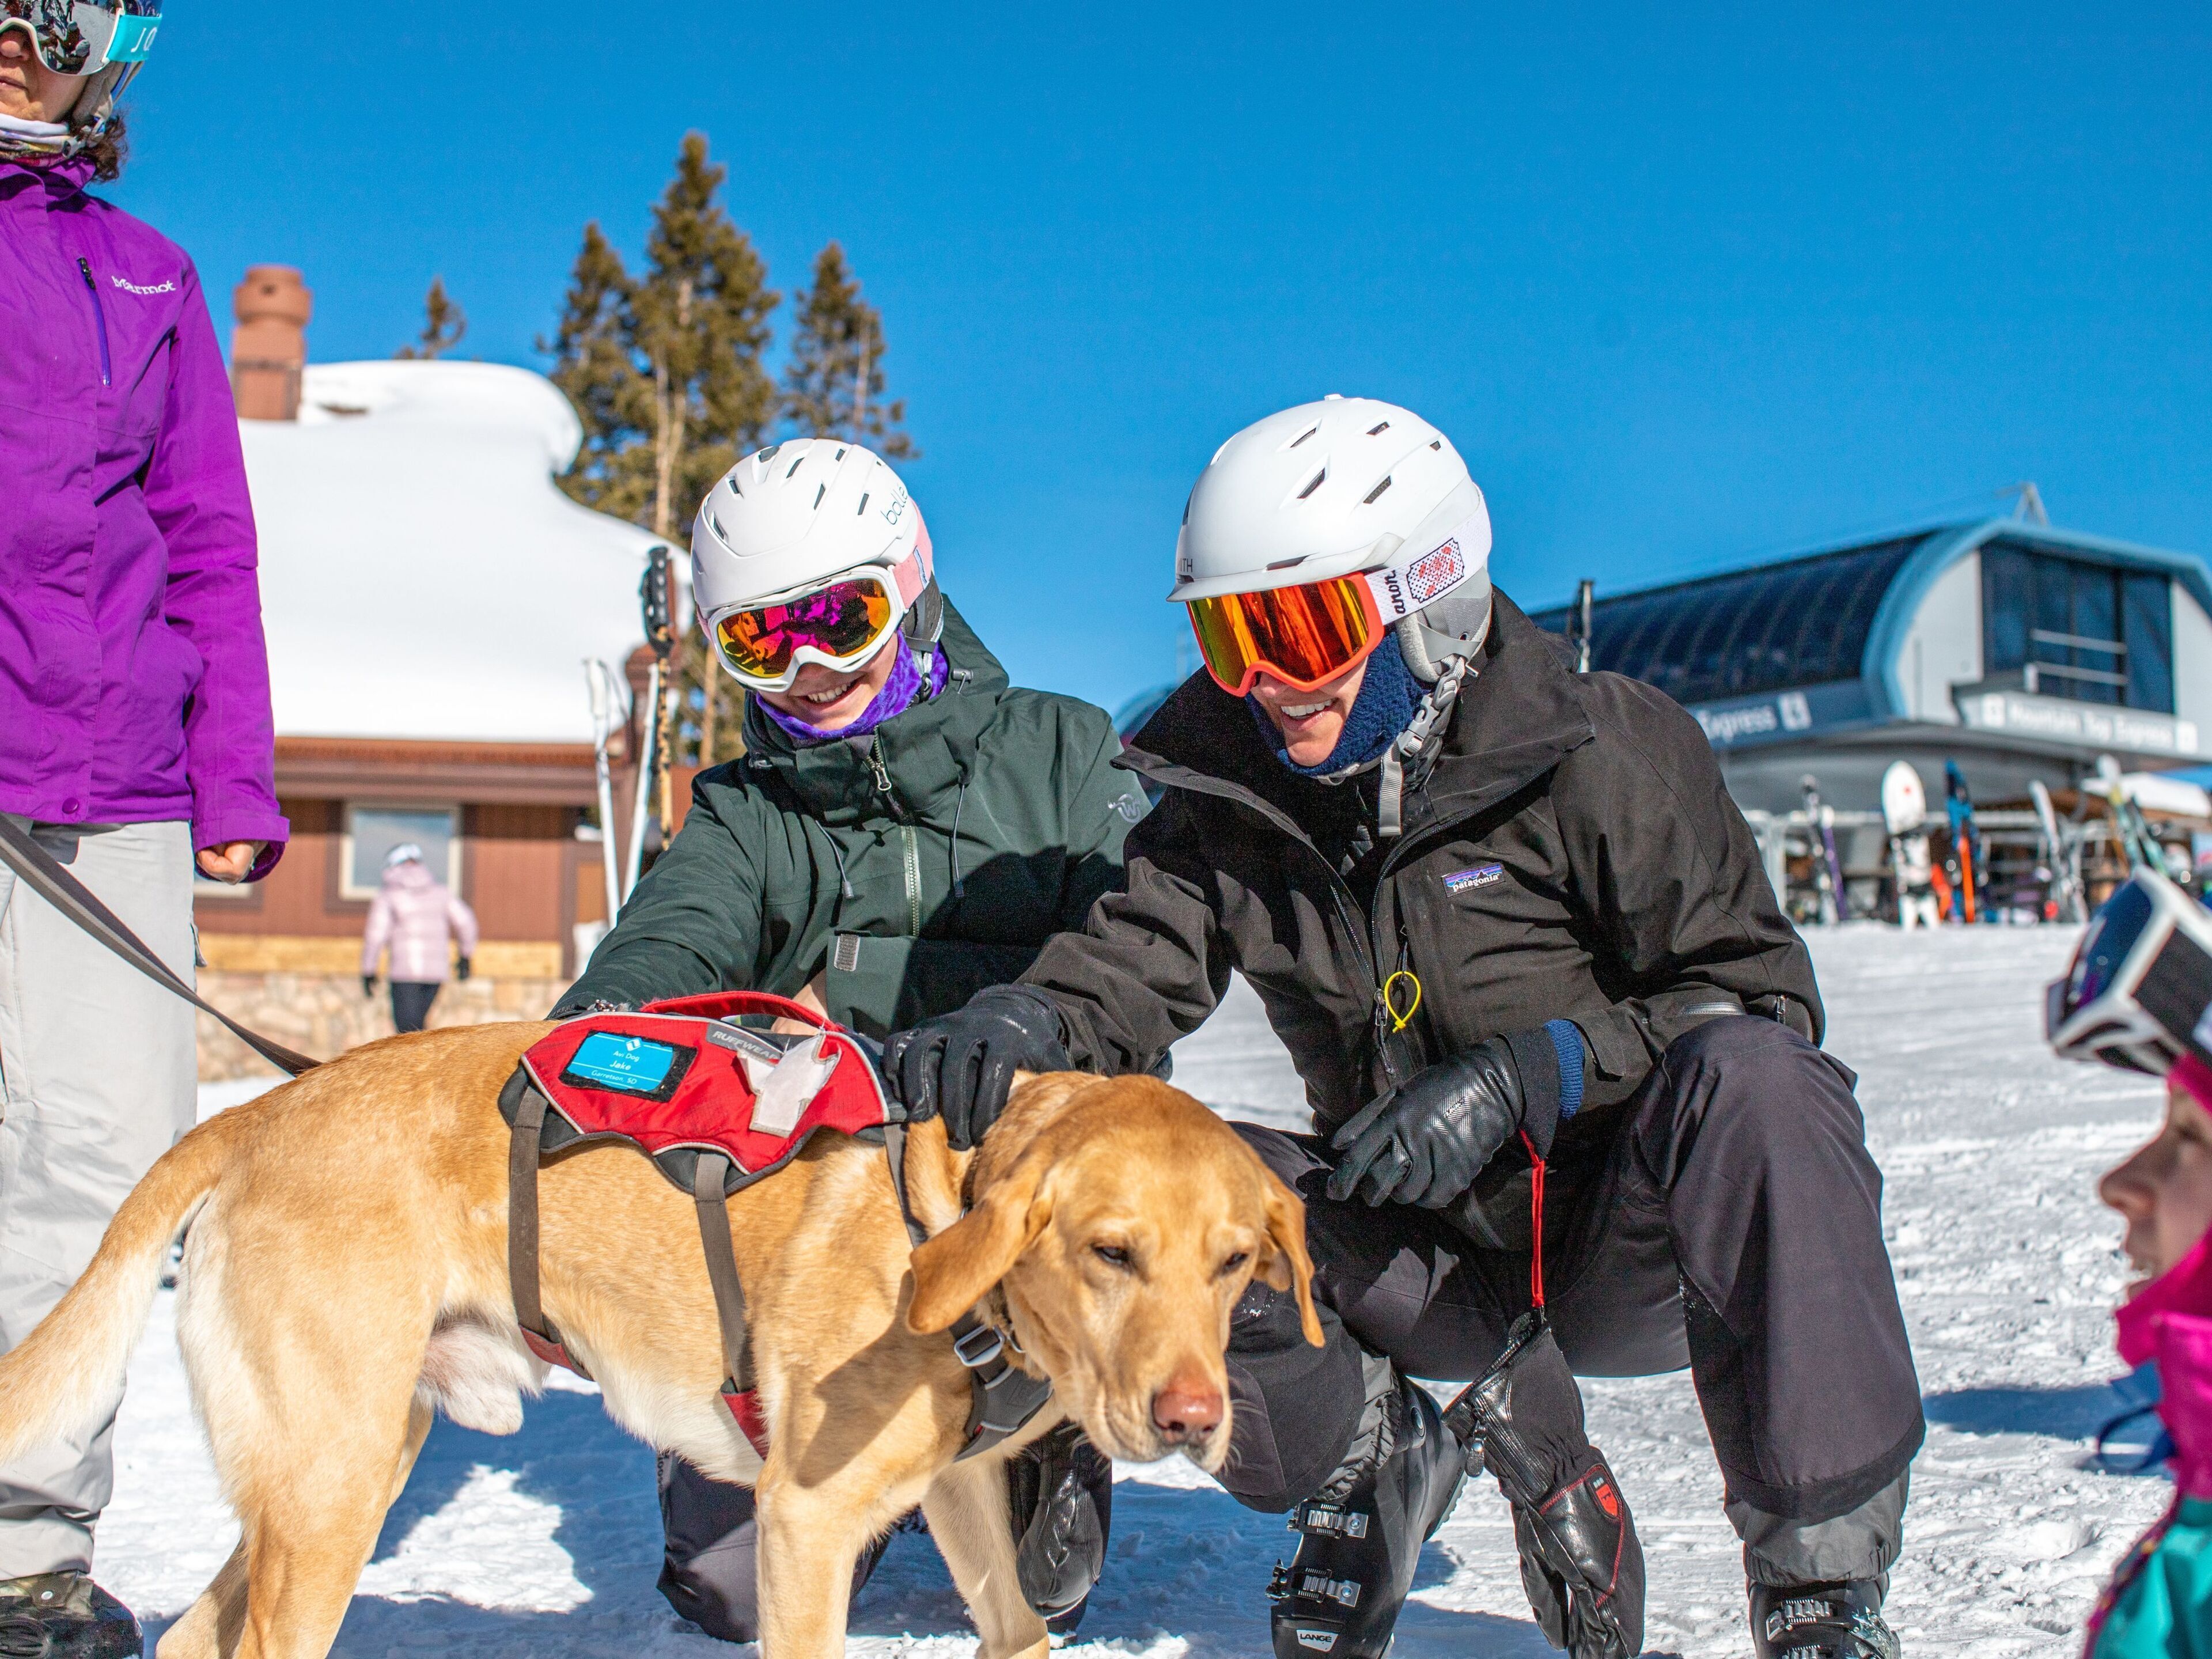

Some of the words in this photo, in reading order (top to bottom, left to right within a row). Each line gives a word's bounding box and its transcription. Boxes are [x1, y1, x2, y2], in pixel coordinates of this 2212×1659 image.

[111, 275, 176, 294] Marmot
[626, 1052, 640, 1062] Dog
[609, 1060, 631, 1071] Jake
[1300, 1634, 1332, 1643] LANGE
